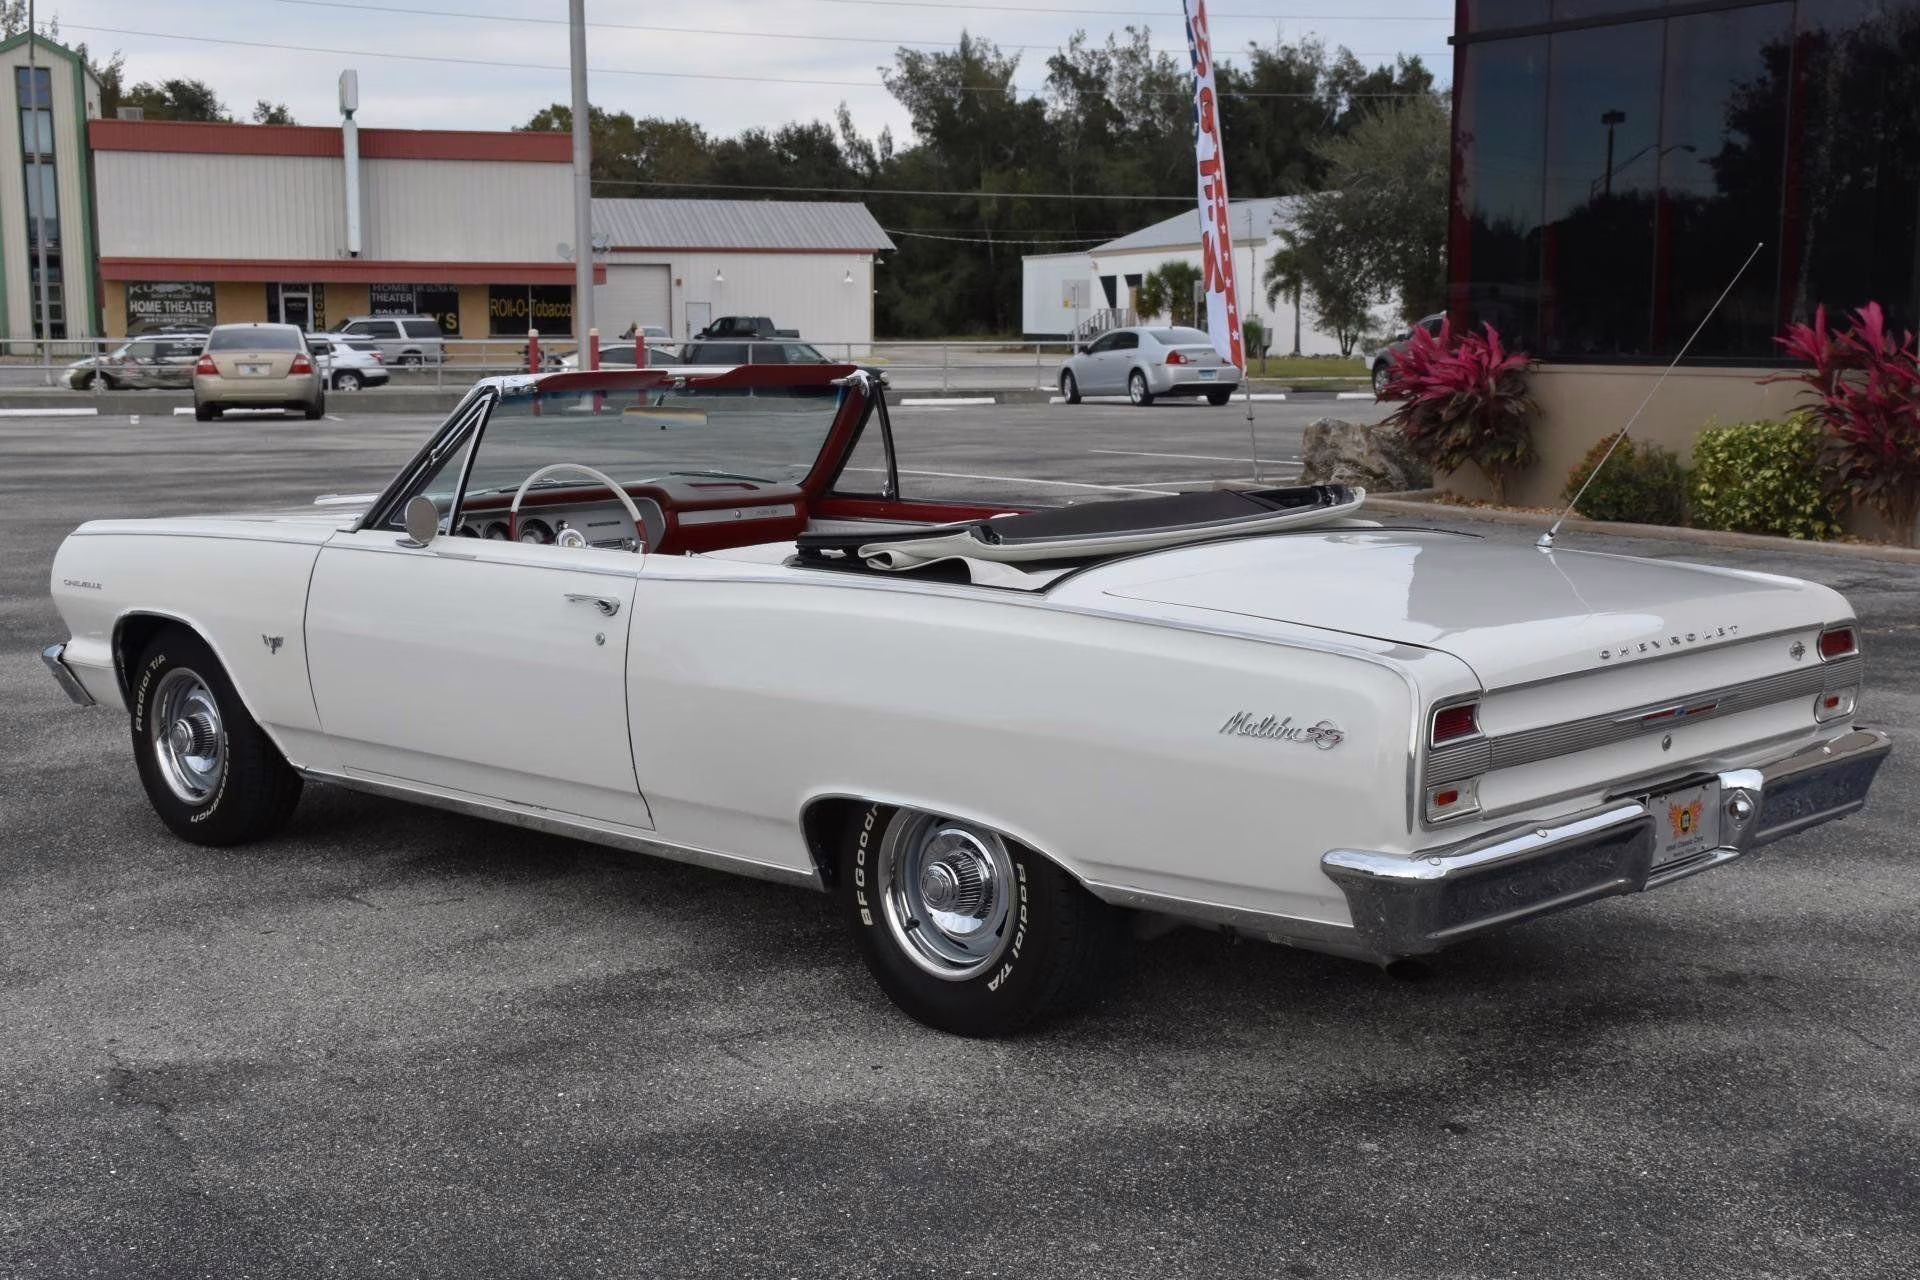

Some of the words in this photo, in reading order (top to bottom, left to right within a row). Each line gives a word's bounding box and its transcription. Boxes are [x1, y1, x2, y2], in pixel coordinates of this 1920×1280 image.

[371, 293, 413, 302] THEATER
[372, 284, 410, 292] HOME
[130, 301, 162, 313] HOME
[164, 301, 214, 313] THEATER
[1600, 625, 1739, 659] CHEVROLET
[1219, 711, 1302, 740] Malibu
[855, 803, 880, 926] BFGoodr
[1012, 863, 1028, 959] Radial
[987, 962, 1013, 992] T/A
